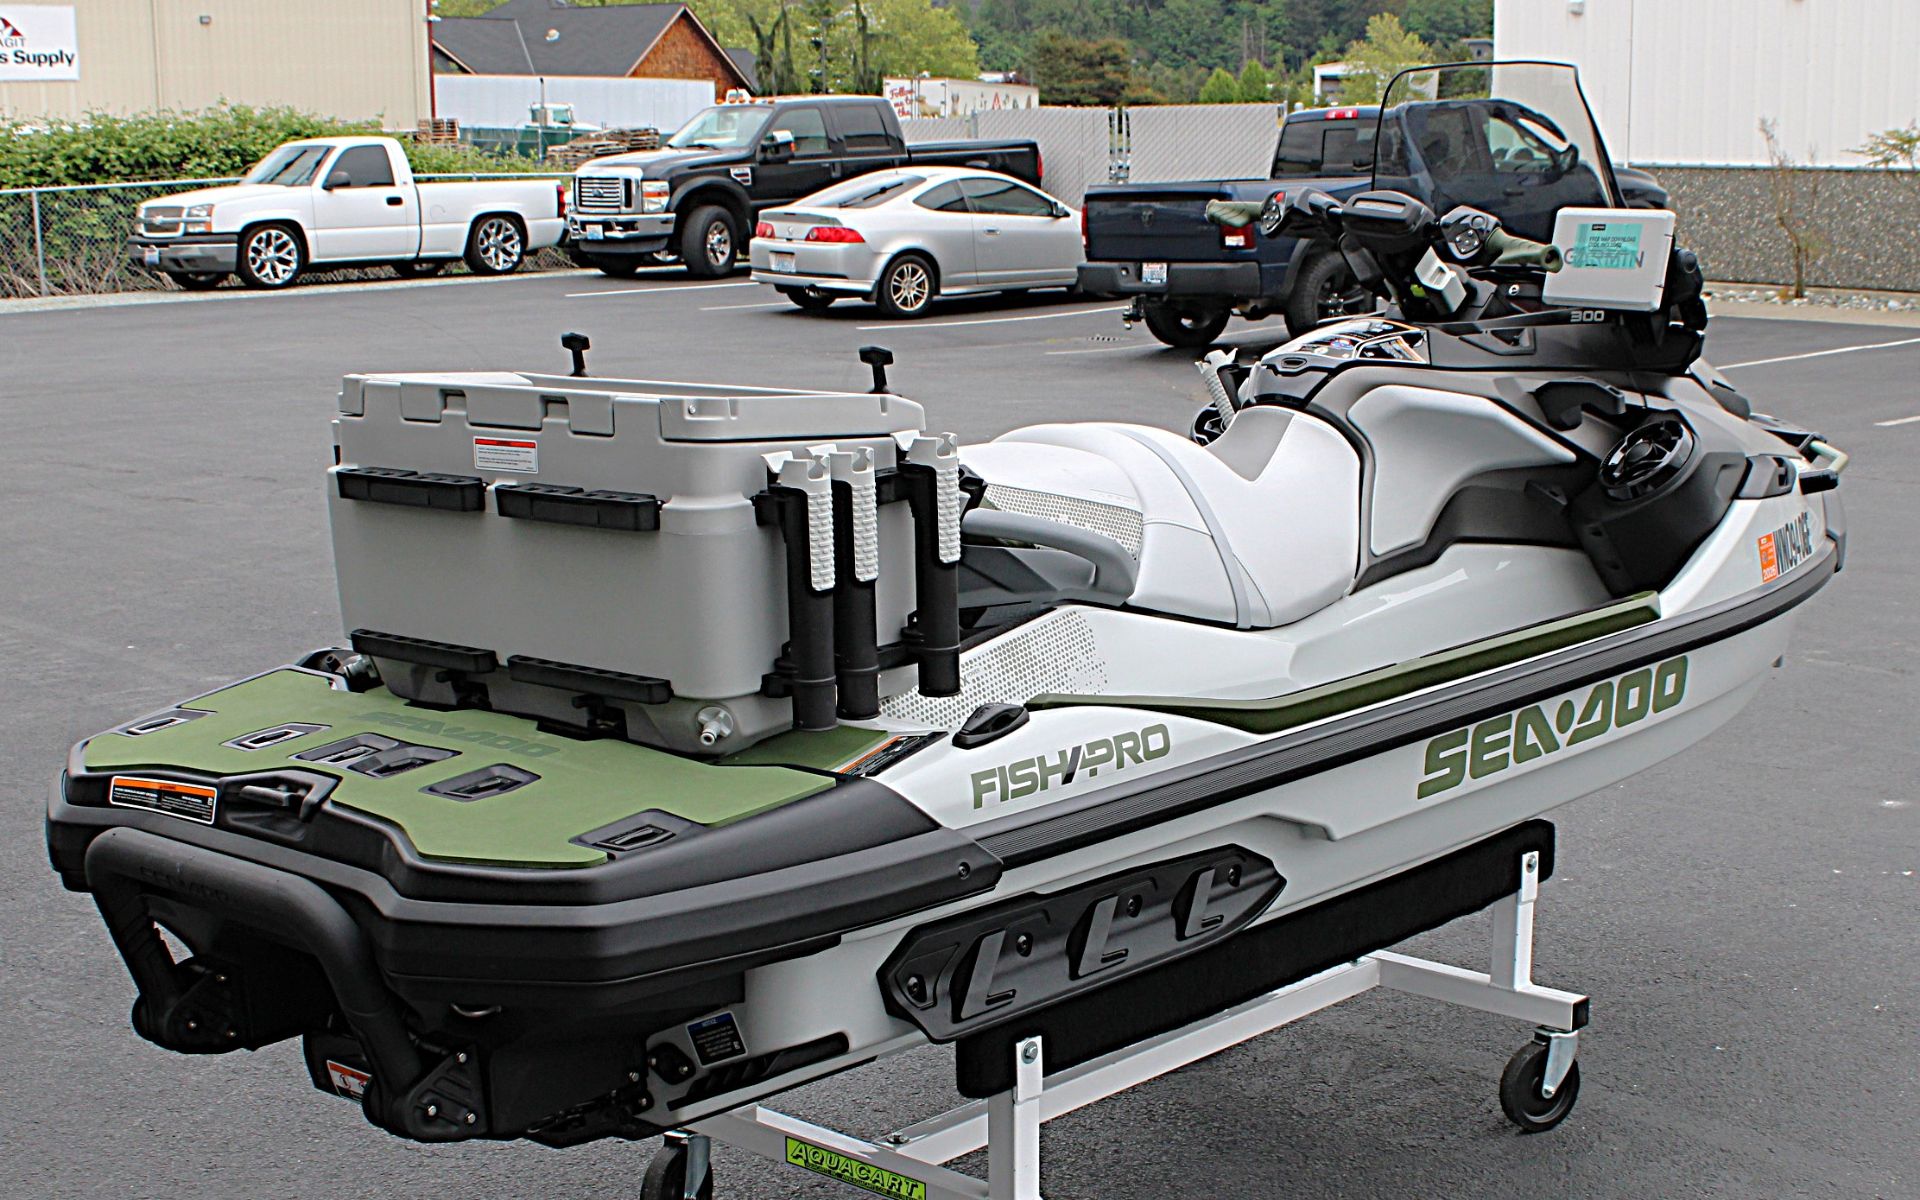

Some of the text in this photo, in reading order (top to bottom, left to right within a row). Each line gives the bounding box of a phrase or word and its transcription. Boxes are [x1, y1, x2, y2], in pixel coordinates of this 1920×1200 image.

[14, 49, 75, 67] Supply
[1570, 310, 1605, 322] 300
[791, 1142, 919, 1198] AQUACART
